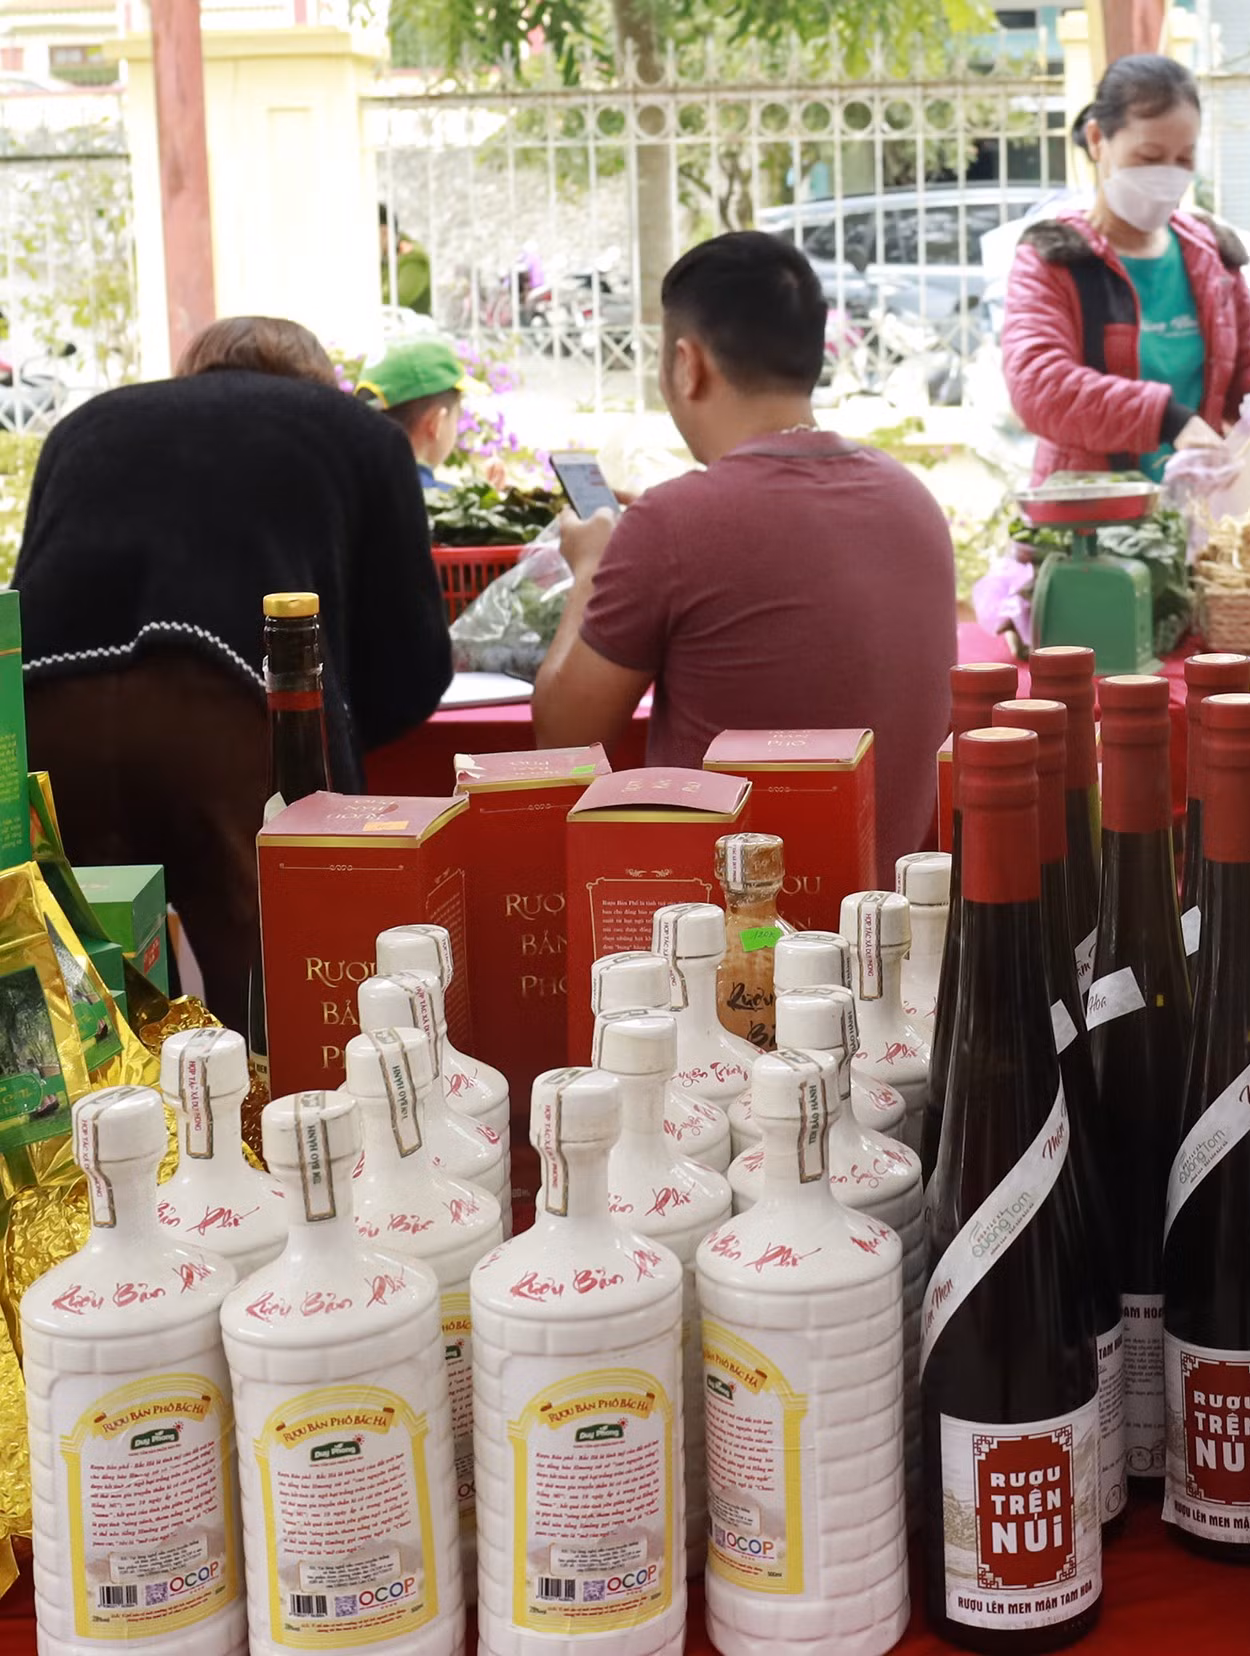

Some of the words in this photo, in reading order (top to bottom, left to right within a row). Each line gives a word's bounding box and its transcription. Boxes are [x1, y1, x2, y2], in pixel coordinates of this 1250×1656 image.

[505, 893, 565, 919] RƯỢ
[990, 1465, 1061, 1488] RƯỢU
[990, 1488, 1062, 1516] TRÊN
[1192, 1506, 1207, 1524] LÊN
[1209, 1512, 1231, 1528] MEN
[726, 1531, 774, 1555] OCOP
[169, 1561, 219, 1593] OCOP
[606, 1564, 657, 1592] OCOP
[358, 1576, 416, 1606] OCOP
[958, 1596, 984, 1613] RƯỢU
[986, 1596, 1004, 1614] LÊN
[1008, 1601, 1032, 1614] MEN
[1035, 1594, 1058, 1612] MẬN
[1060, 1590, 1079, 1606] TAM
